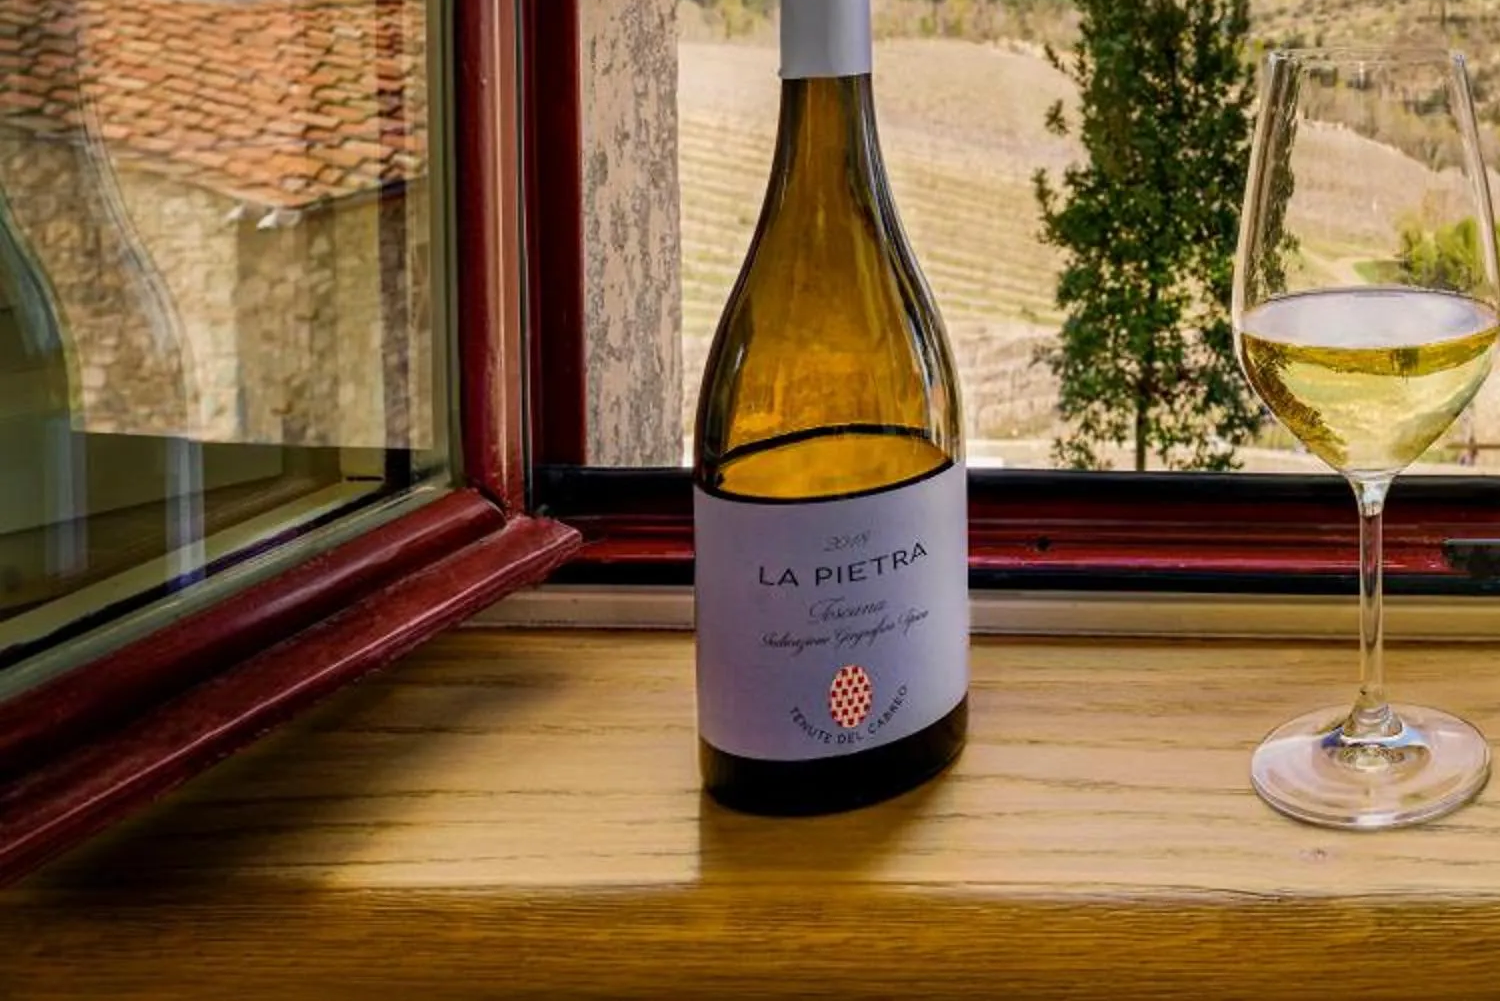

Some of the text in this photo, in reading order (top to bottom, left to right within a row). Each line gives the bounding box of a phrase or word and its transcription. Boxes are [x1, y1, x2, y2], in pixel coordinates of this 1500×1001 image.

[759, 542, 928, 587] LA PIETRA
[808, 596, 887, 626] Toscana
[789, 684, 909, 745] TENUTE DEL CABREO
